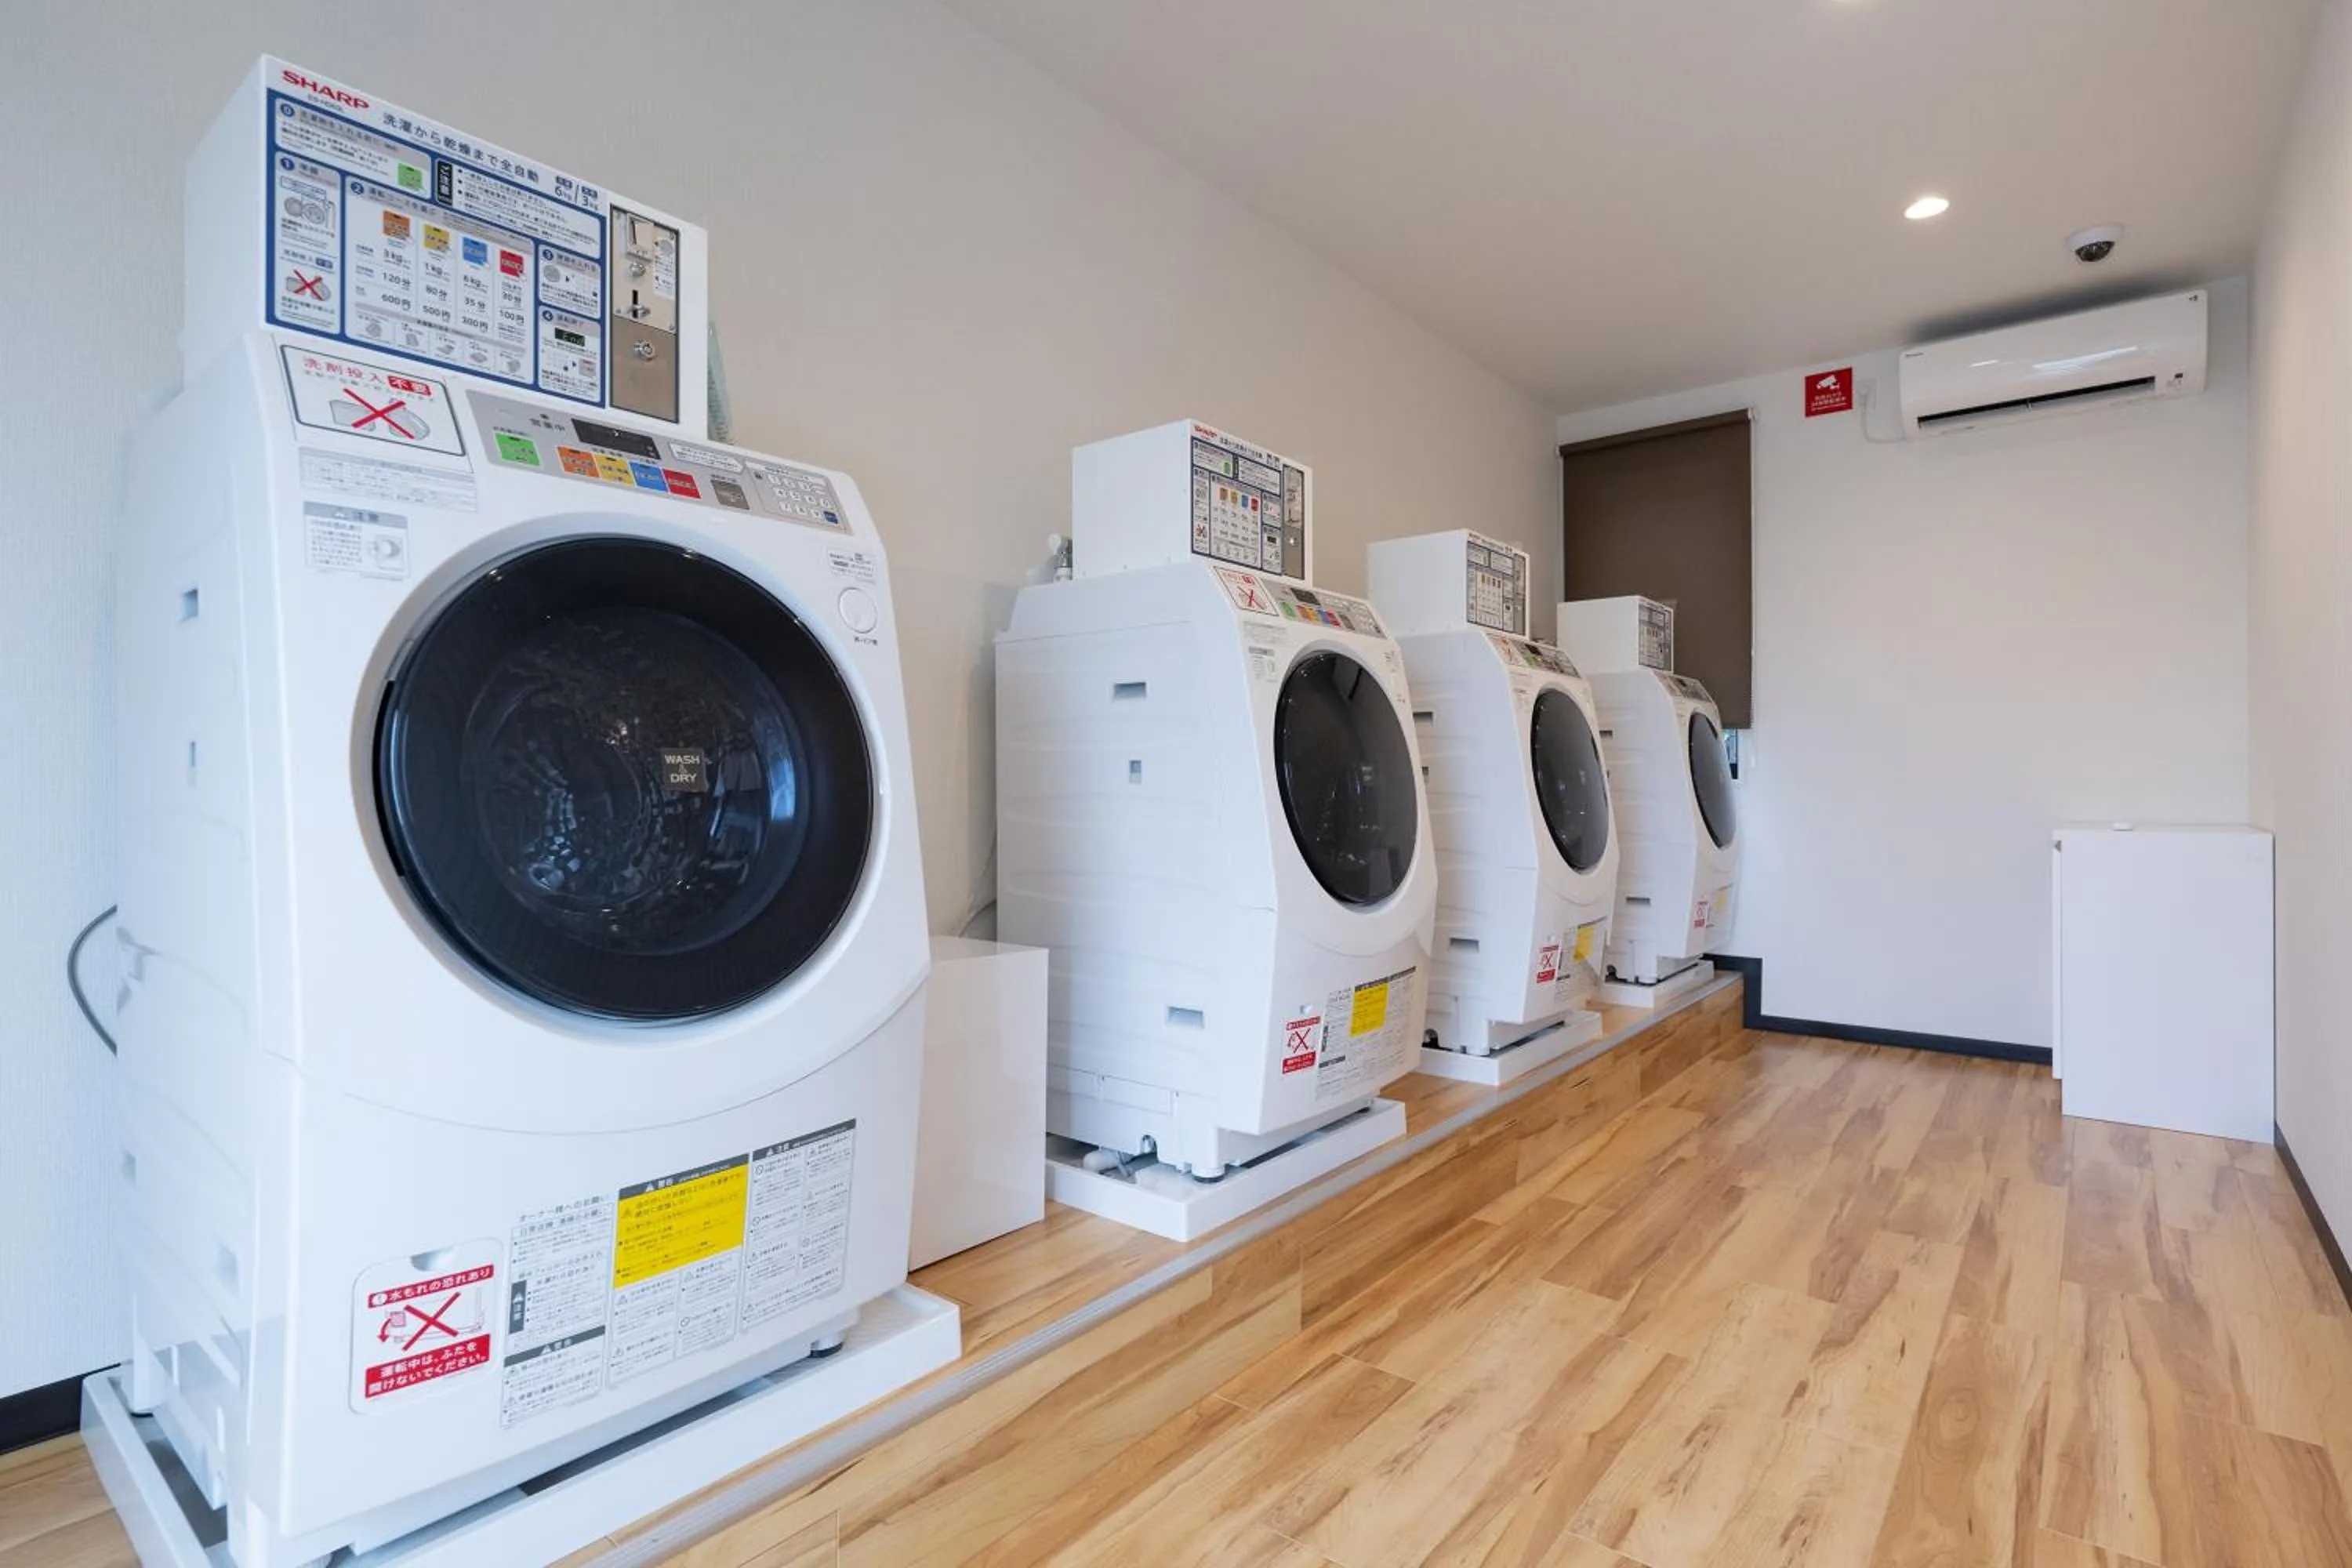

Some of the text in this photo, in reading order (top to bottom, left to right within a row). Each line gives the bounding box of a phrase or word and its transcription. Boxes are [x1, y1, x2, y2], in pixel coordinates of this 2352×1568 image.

[282, 69, 369, 109] SHARP
[383, 111, 539, 183] 洗濯から乾燥まで全自動
[665, 755, 700, 764] WASH
[670, 774, 697, 783] DRY
[390, 1267, 491, 1301] 水もれの恐れあり
[380, 1341, 477, 1377] 運転中は、ふたを
